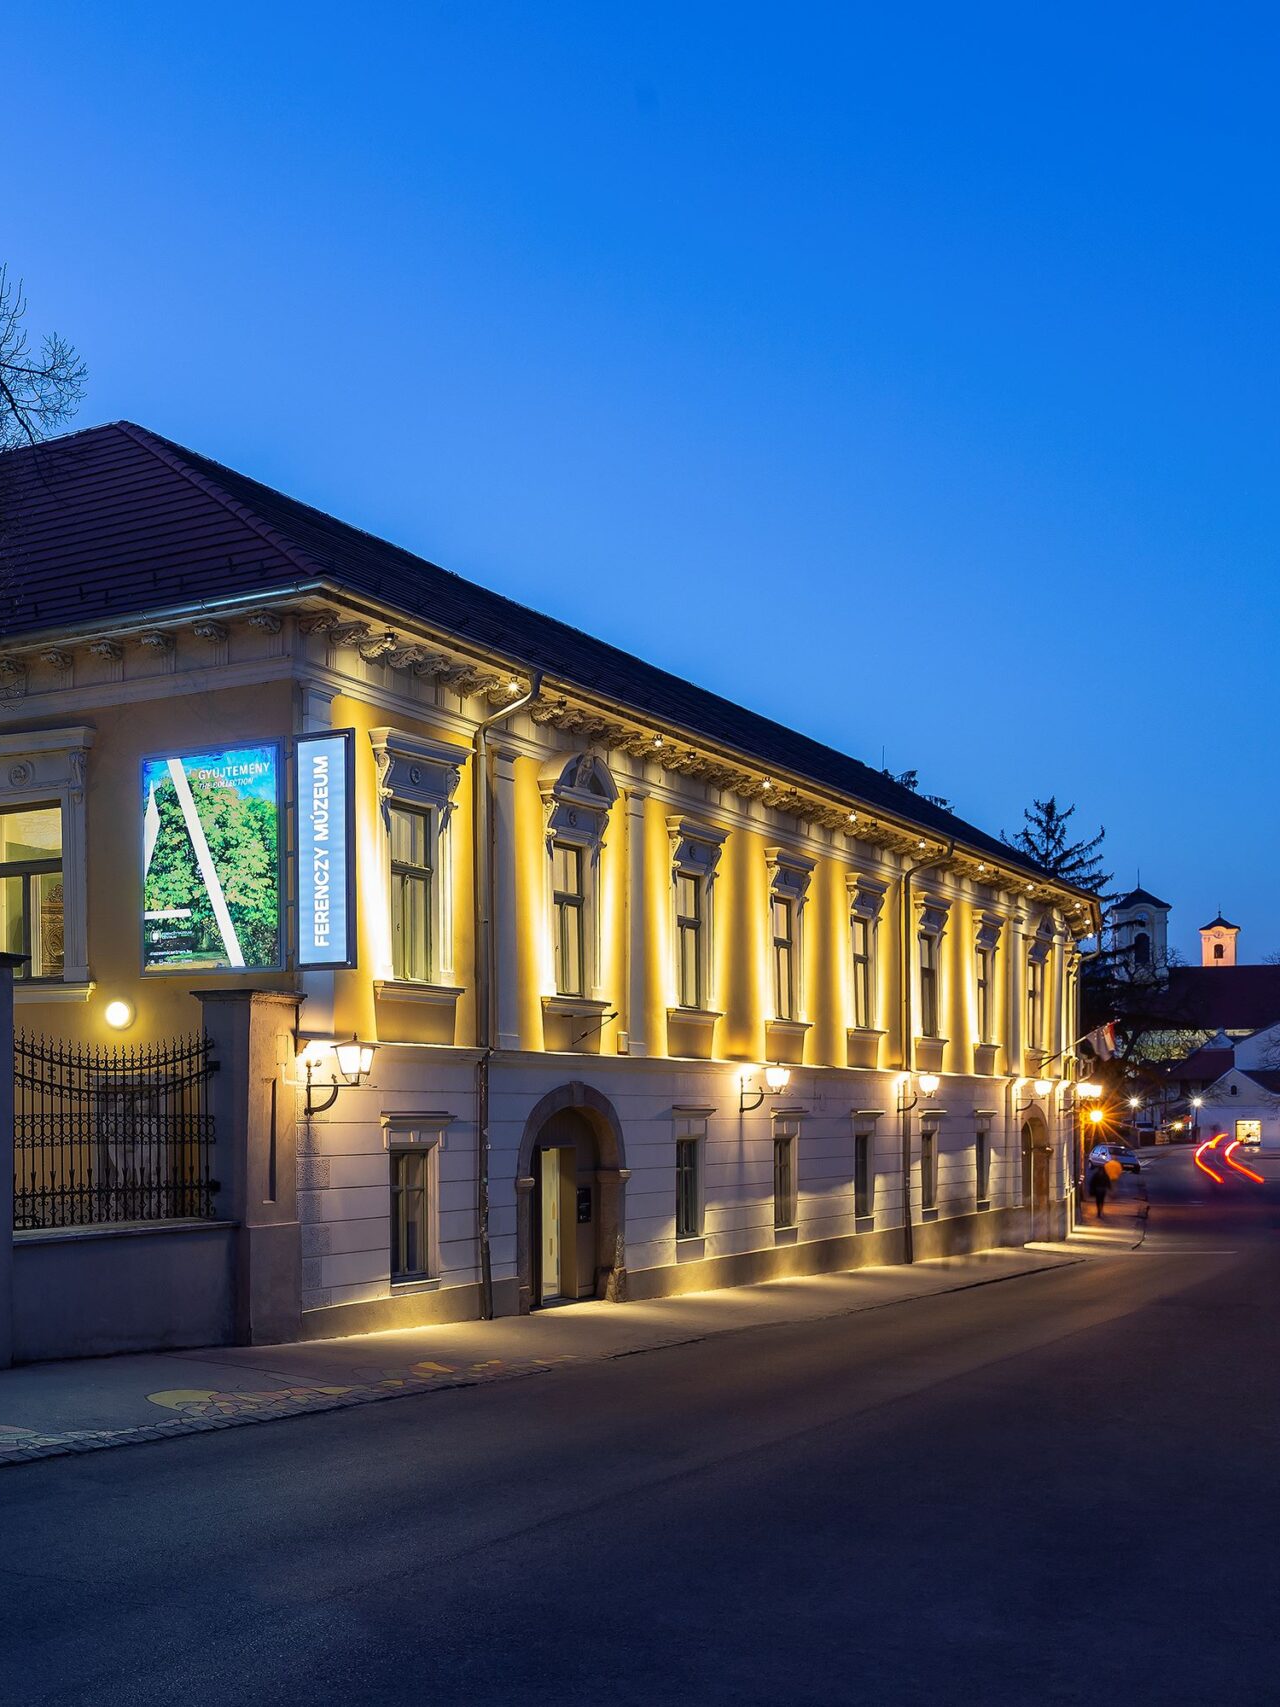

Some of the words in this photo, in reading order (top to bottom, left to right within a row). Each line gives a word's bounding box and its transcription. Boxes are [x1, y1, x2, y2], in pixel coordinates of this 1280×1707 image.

[213, 777, 254, 789] COLLECTION
[310, 754, 329, 842] MÚZEUM
[312, 846, 330, 947] FERENCZY
